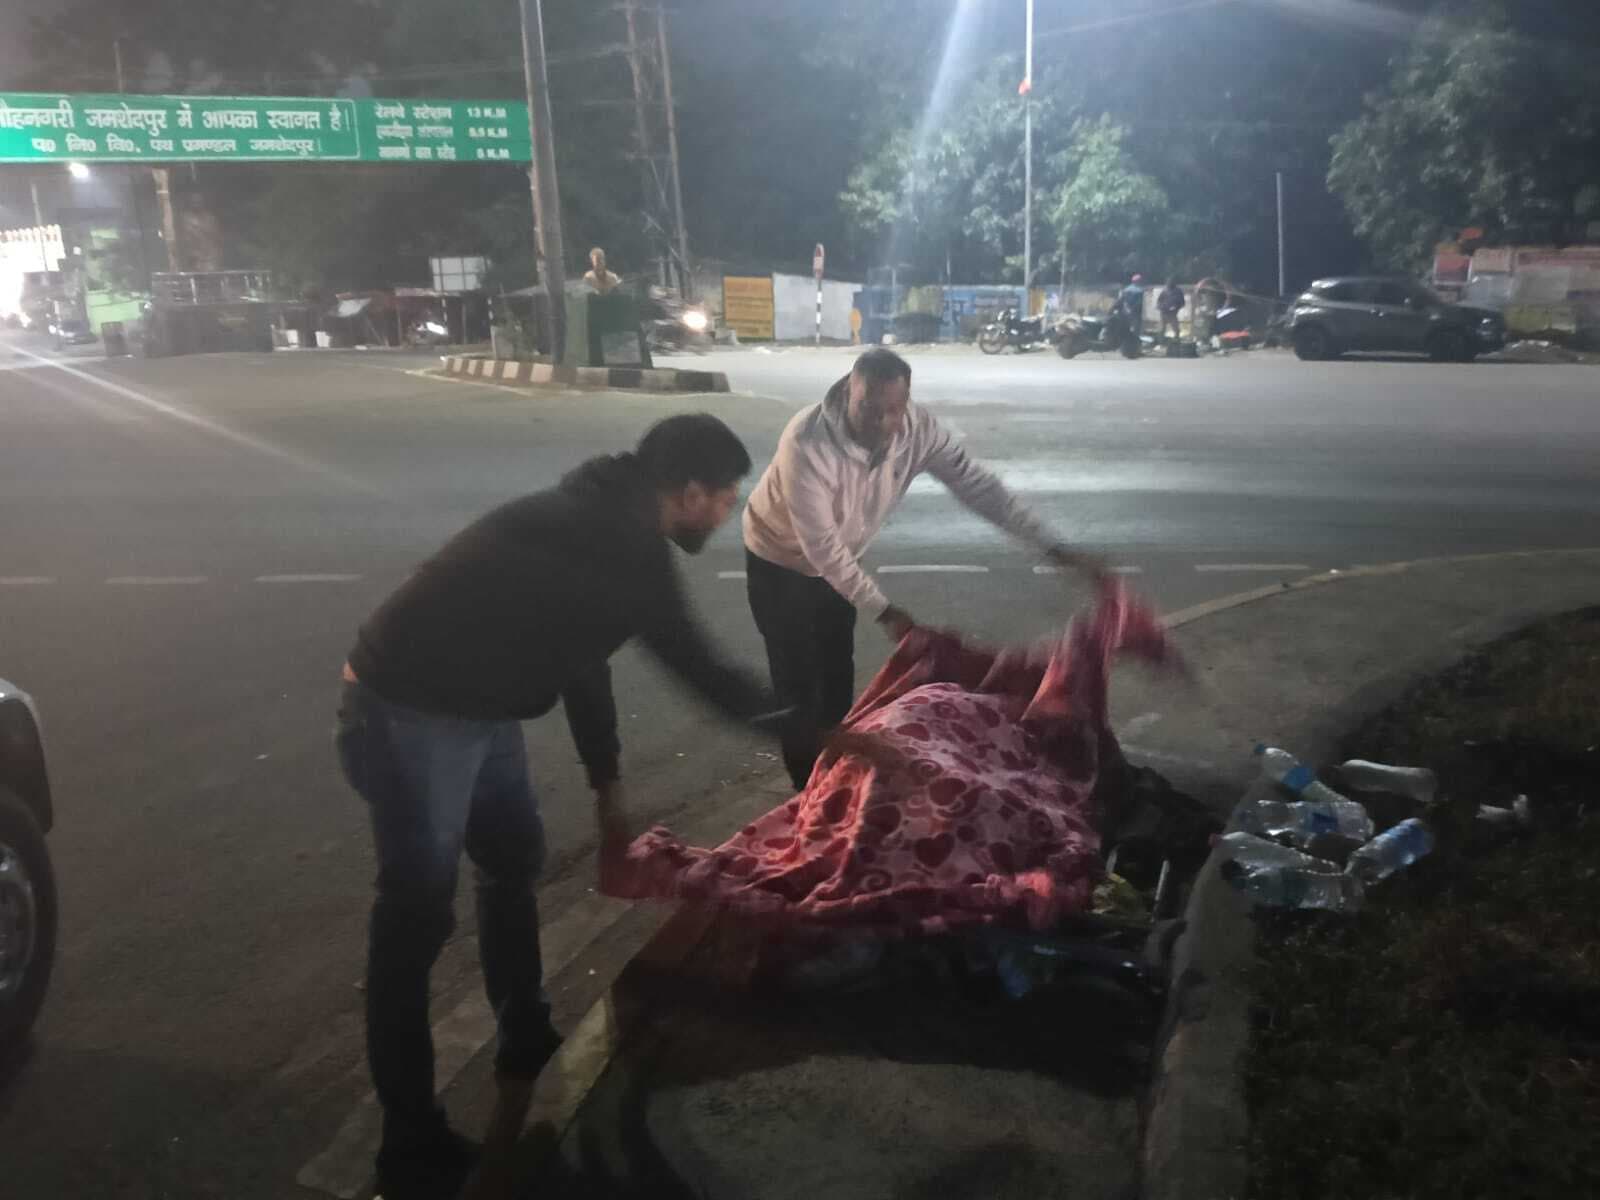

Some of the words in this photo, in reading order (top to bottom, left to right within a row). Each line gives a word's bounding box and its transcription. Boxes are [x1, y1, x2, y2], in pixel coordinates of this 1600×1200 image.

[83, 102, 167, 136] जमशेदपुर
[176, 101, 192, 128] में
[202, 110, 258, 128] आपका
[266, 110, 321, 129] स्वागत
[412, 103, 452, 119] स्टेशन
